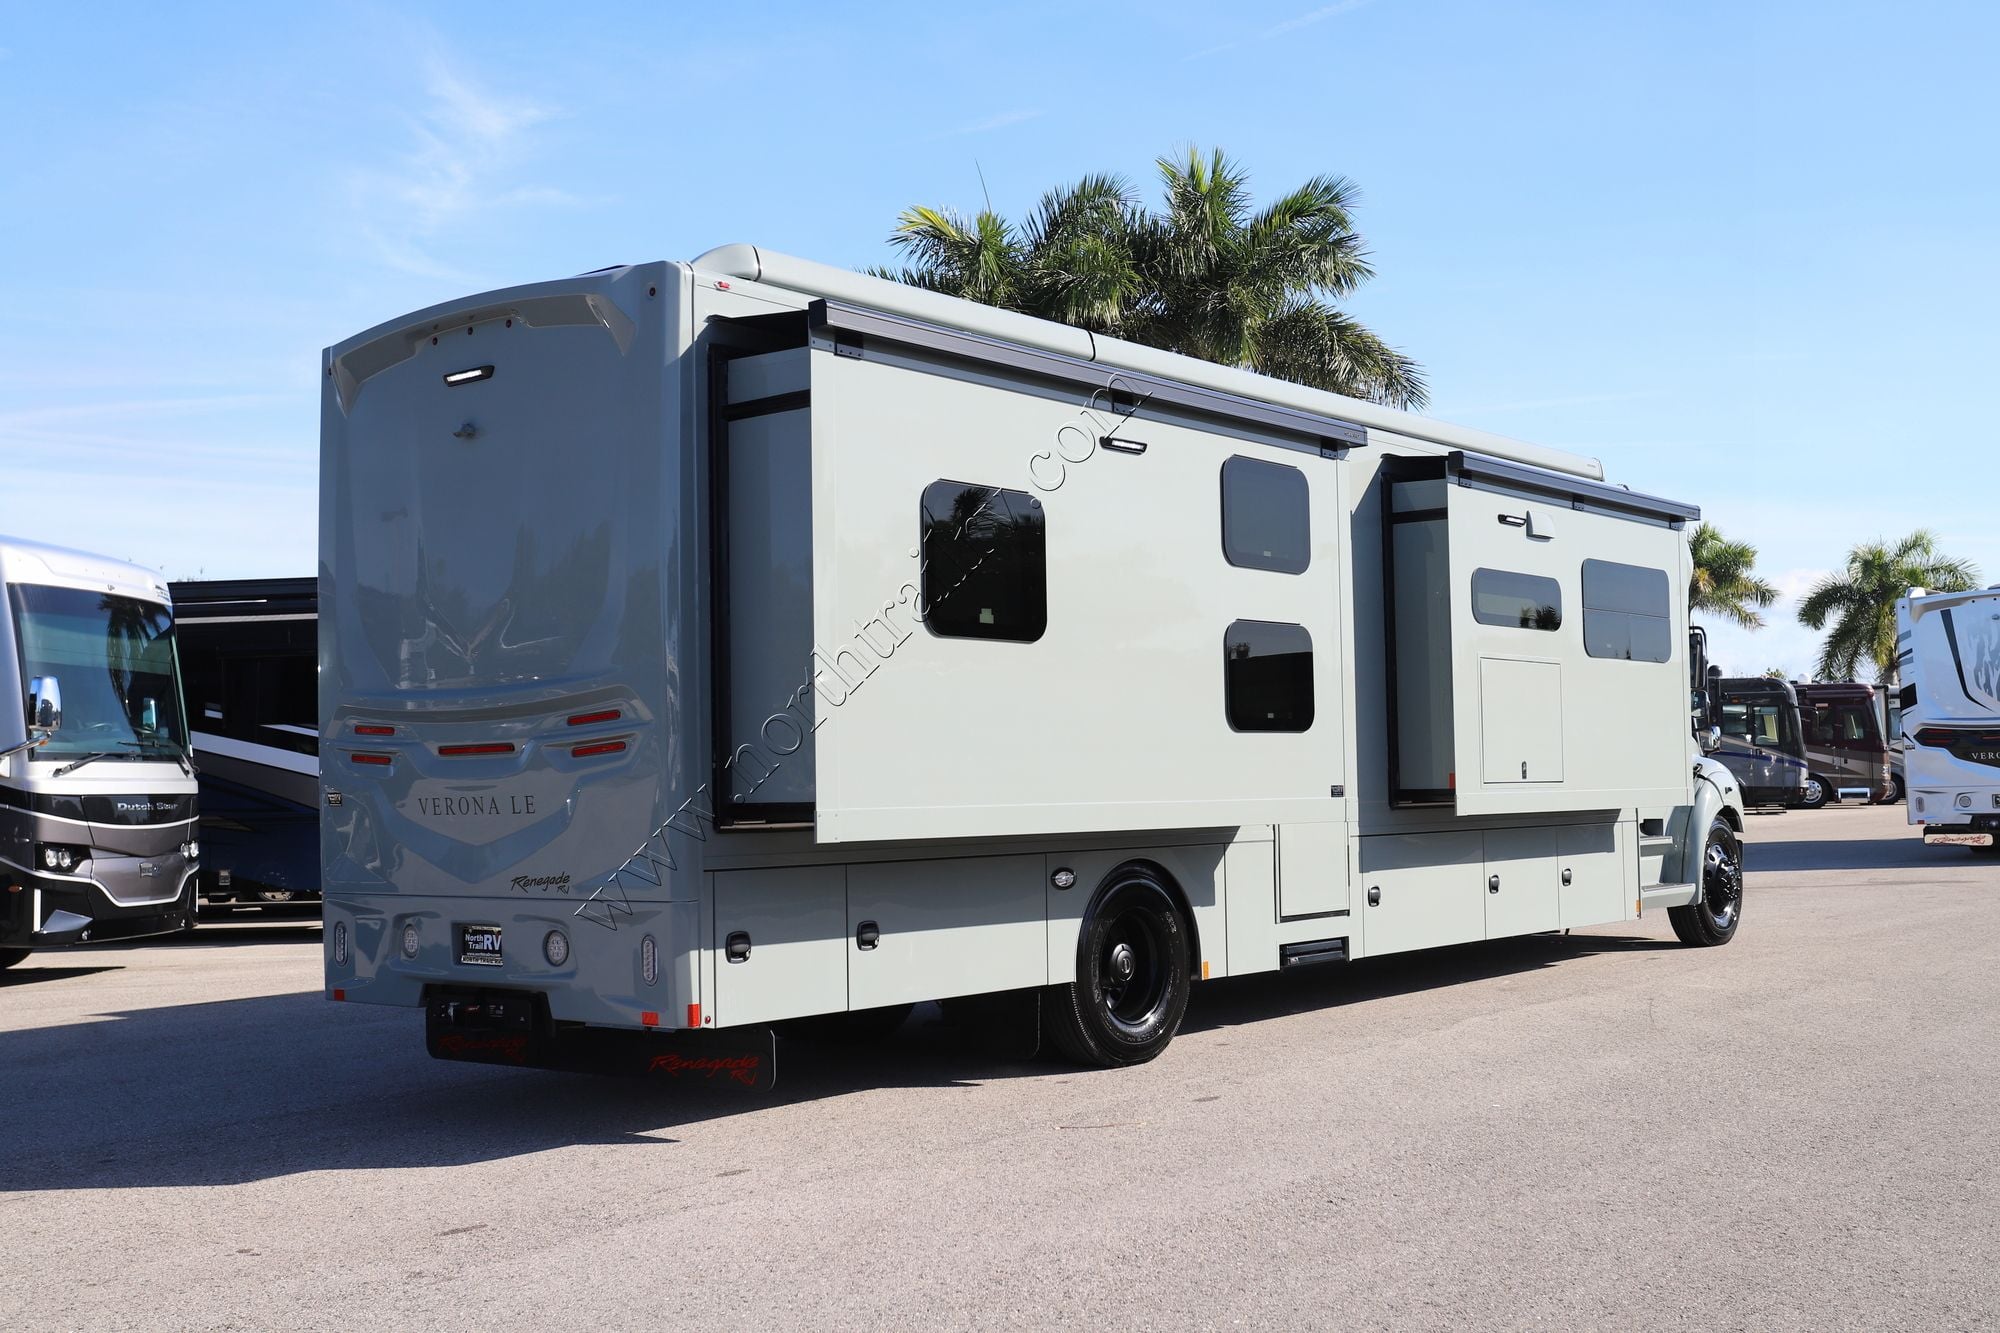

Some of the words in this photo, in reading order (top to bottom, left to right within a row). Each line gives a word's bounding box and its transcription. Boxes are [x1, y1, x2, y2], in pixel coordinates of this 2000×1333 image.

[117, 802, 154, 811] Dutch
[156, 802, 179, 810] Star
[418, 796, 500, 816] VERONA
[510, 795, 536, 815] LE
[511, 872, 571, 893] Renegade
[465, 933, 484, 941] North
[484, 934, 502, 950] RV
[468, 942, 484, 950] Trail
[648, 1052, 760, 1078] Renegade
